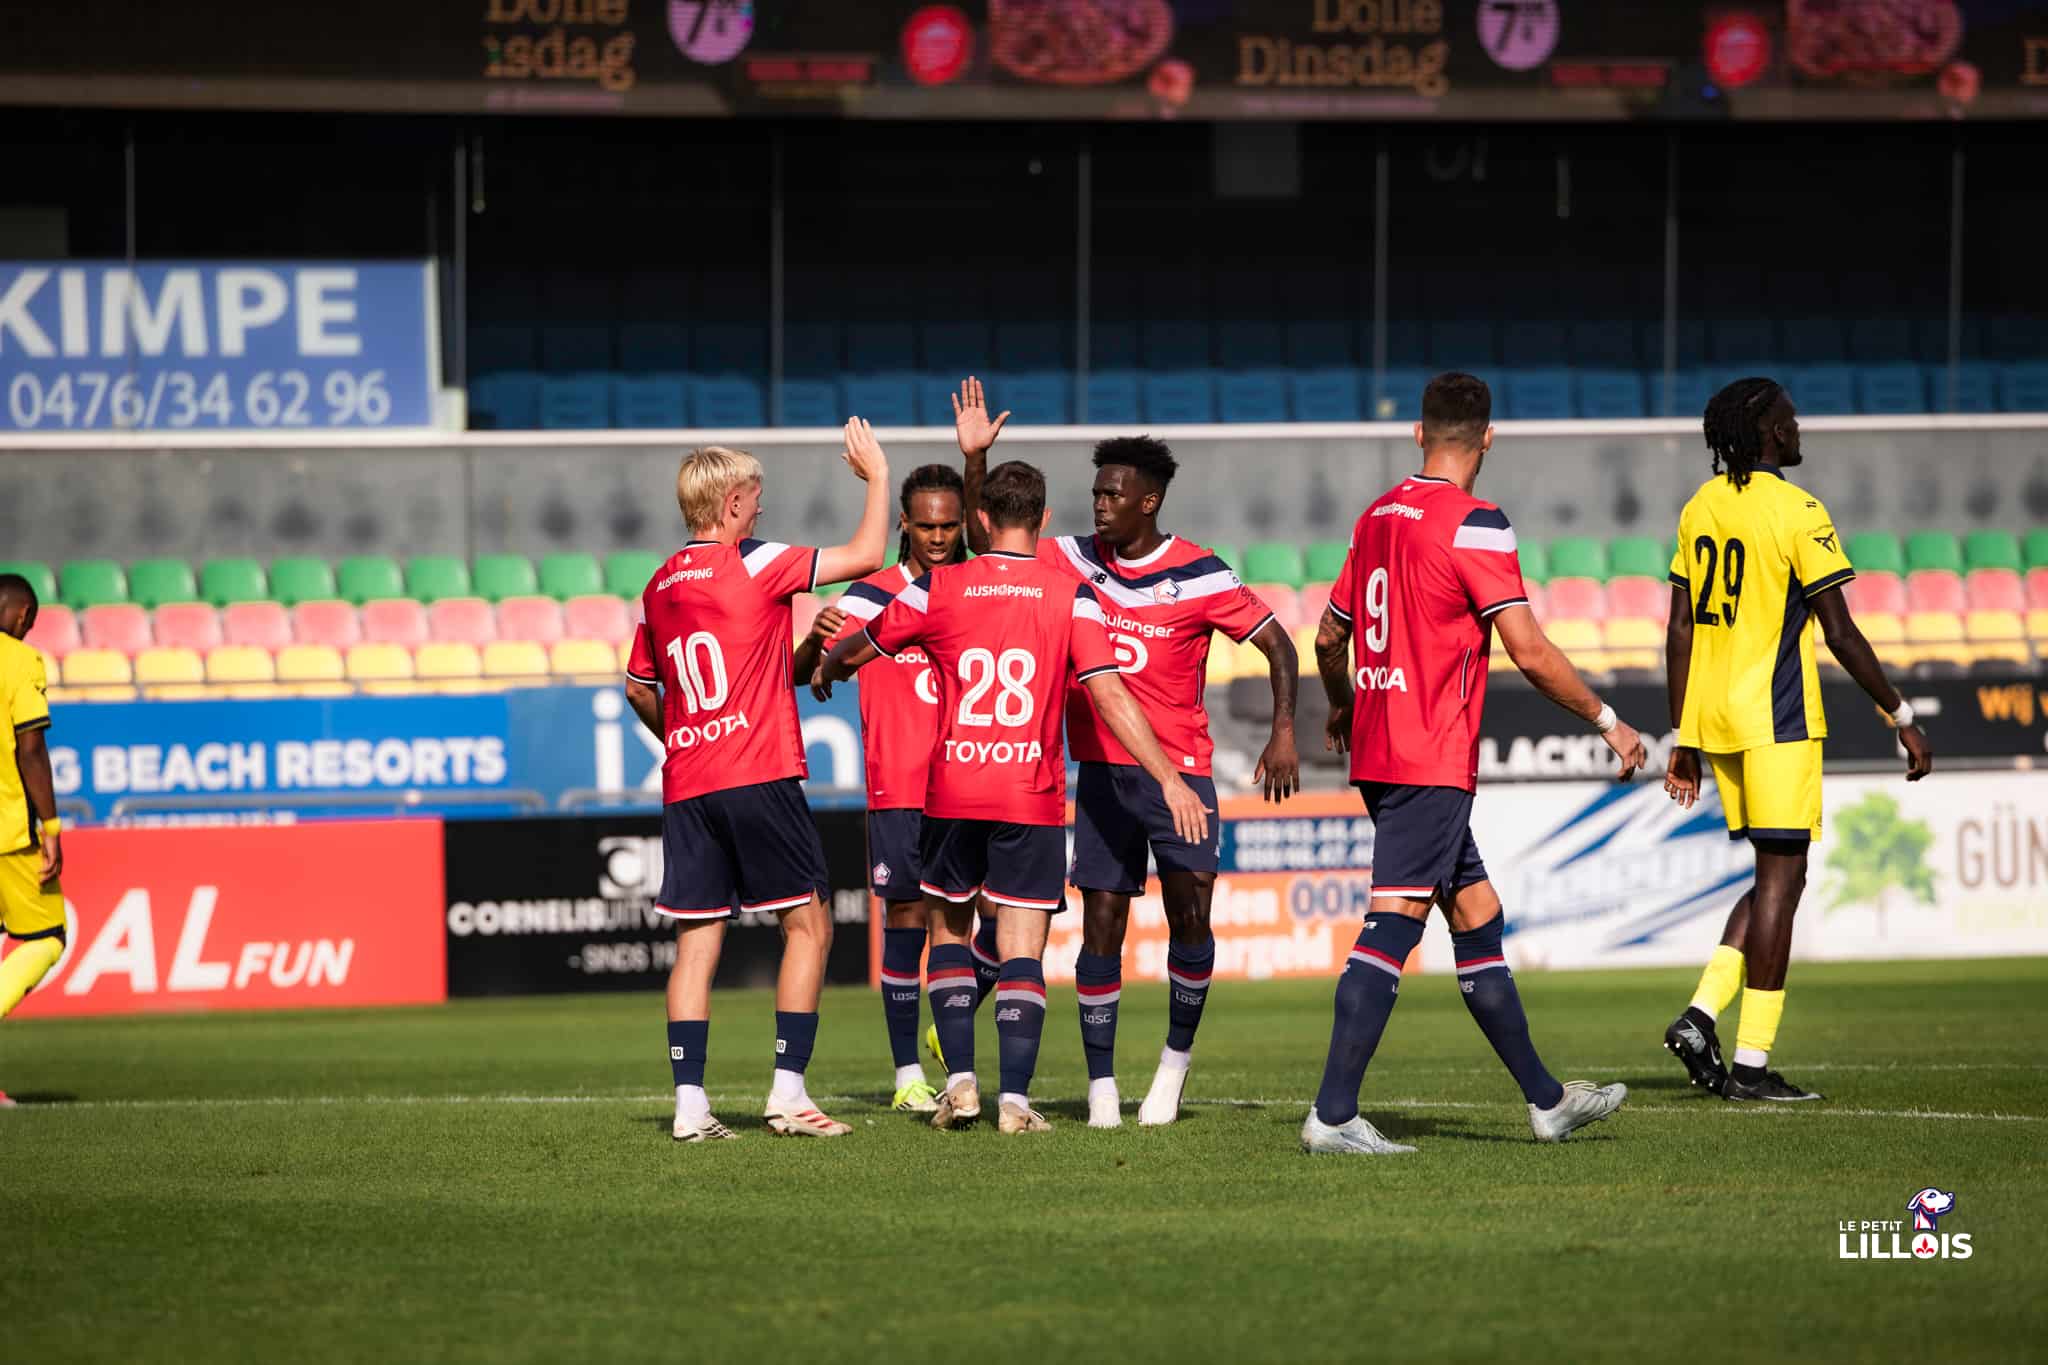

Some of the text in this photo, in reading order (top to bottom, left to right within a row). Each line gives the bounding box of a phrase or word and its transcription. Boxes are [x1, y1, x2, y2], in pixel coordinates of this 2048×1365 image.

[1234, 36, 1450, 96] Dinsdag
[0, 267, 362, 358] KIMPE
[10, 369, 391, 429] 0476/34 62 96
[964, 584, 1043, 598] AUSHOPPING
[1366, 567, 1389, 653] 9
[1695, 535, 1745, 629] 29
[667, 631, 728, 714] 10
[957, 648, 1036, 727] 28
[92, 742, 267, 793] BEACH
[275, 737, 507, 790] RESORTS
[945, 740, 1042, 764] TOYOTA
[234, 938, 354, 990] FUN
[1084, 1012, 1112, 1025] LOSC
[672, 1048, 682, 1057] 10
